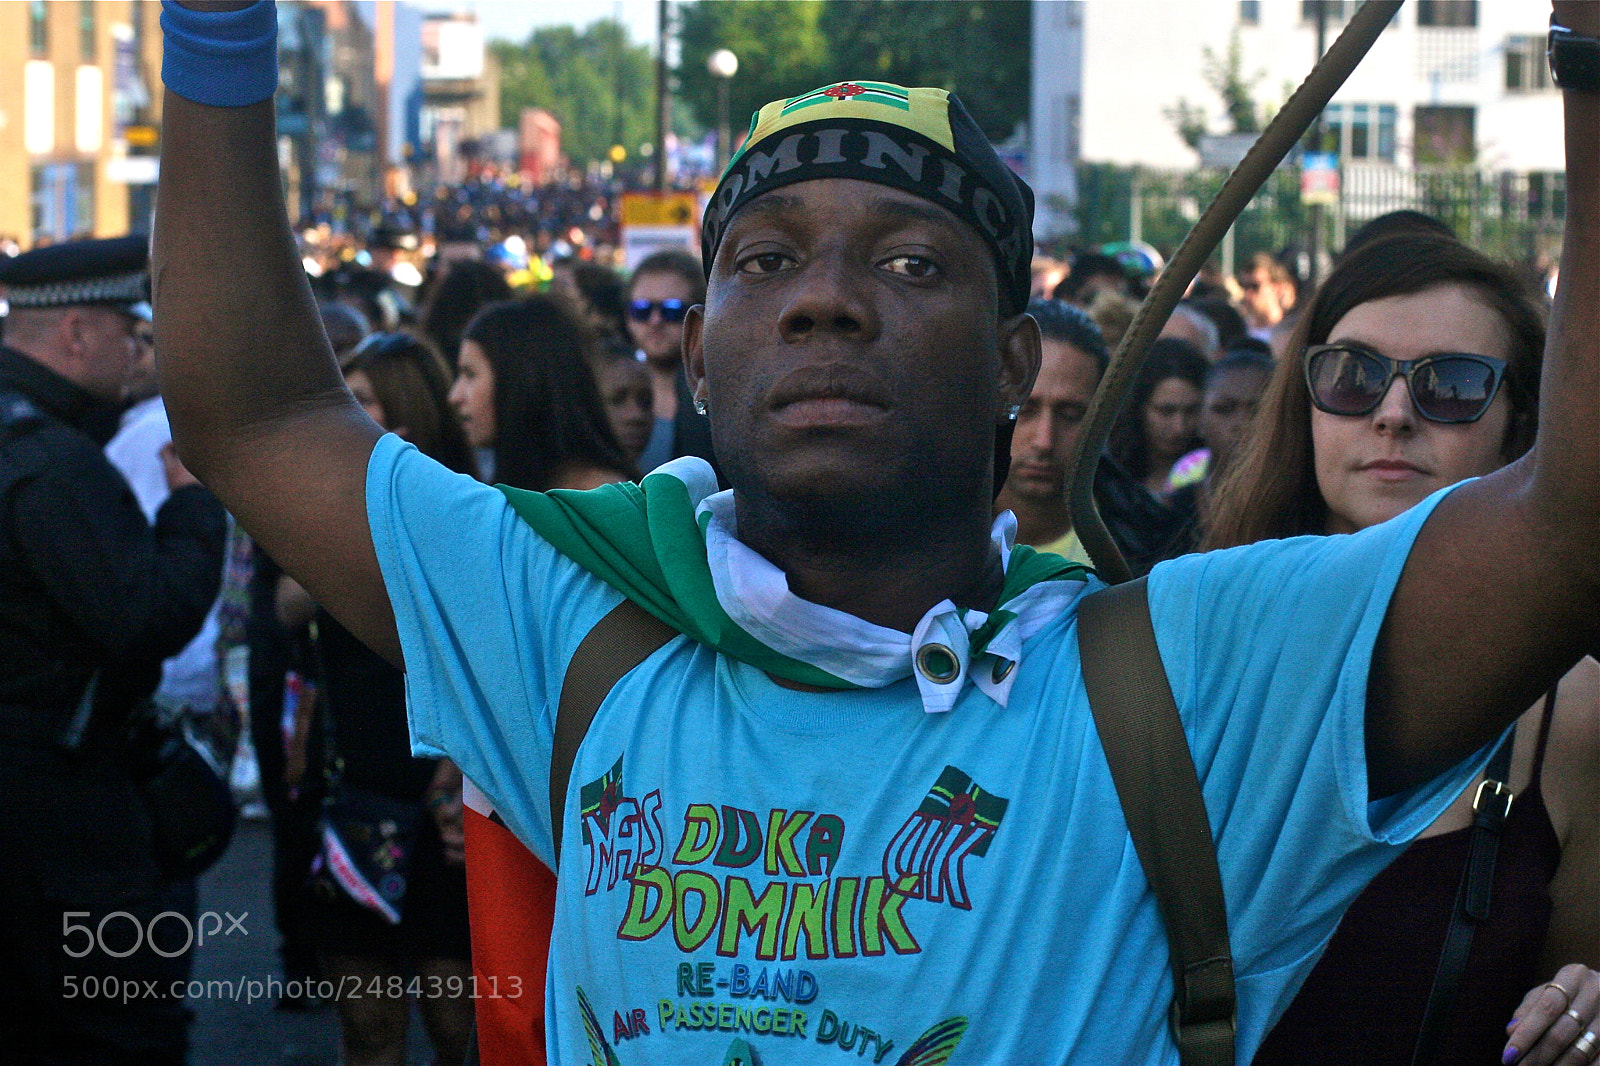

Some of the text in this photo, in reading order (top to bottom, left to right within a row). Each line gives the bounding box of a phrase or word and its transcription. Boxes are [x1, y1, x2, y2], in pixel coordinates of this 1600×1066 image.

[583, 788, 999, 911] MAS DUKA UK
[617, 862, 922, 961] DOMNIK
[677, 961, 818, 1002] RE-BAND
[613, 999, 894, 1064] AIR PASSENGER DUTY
